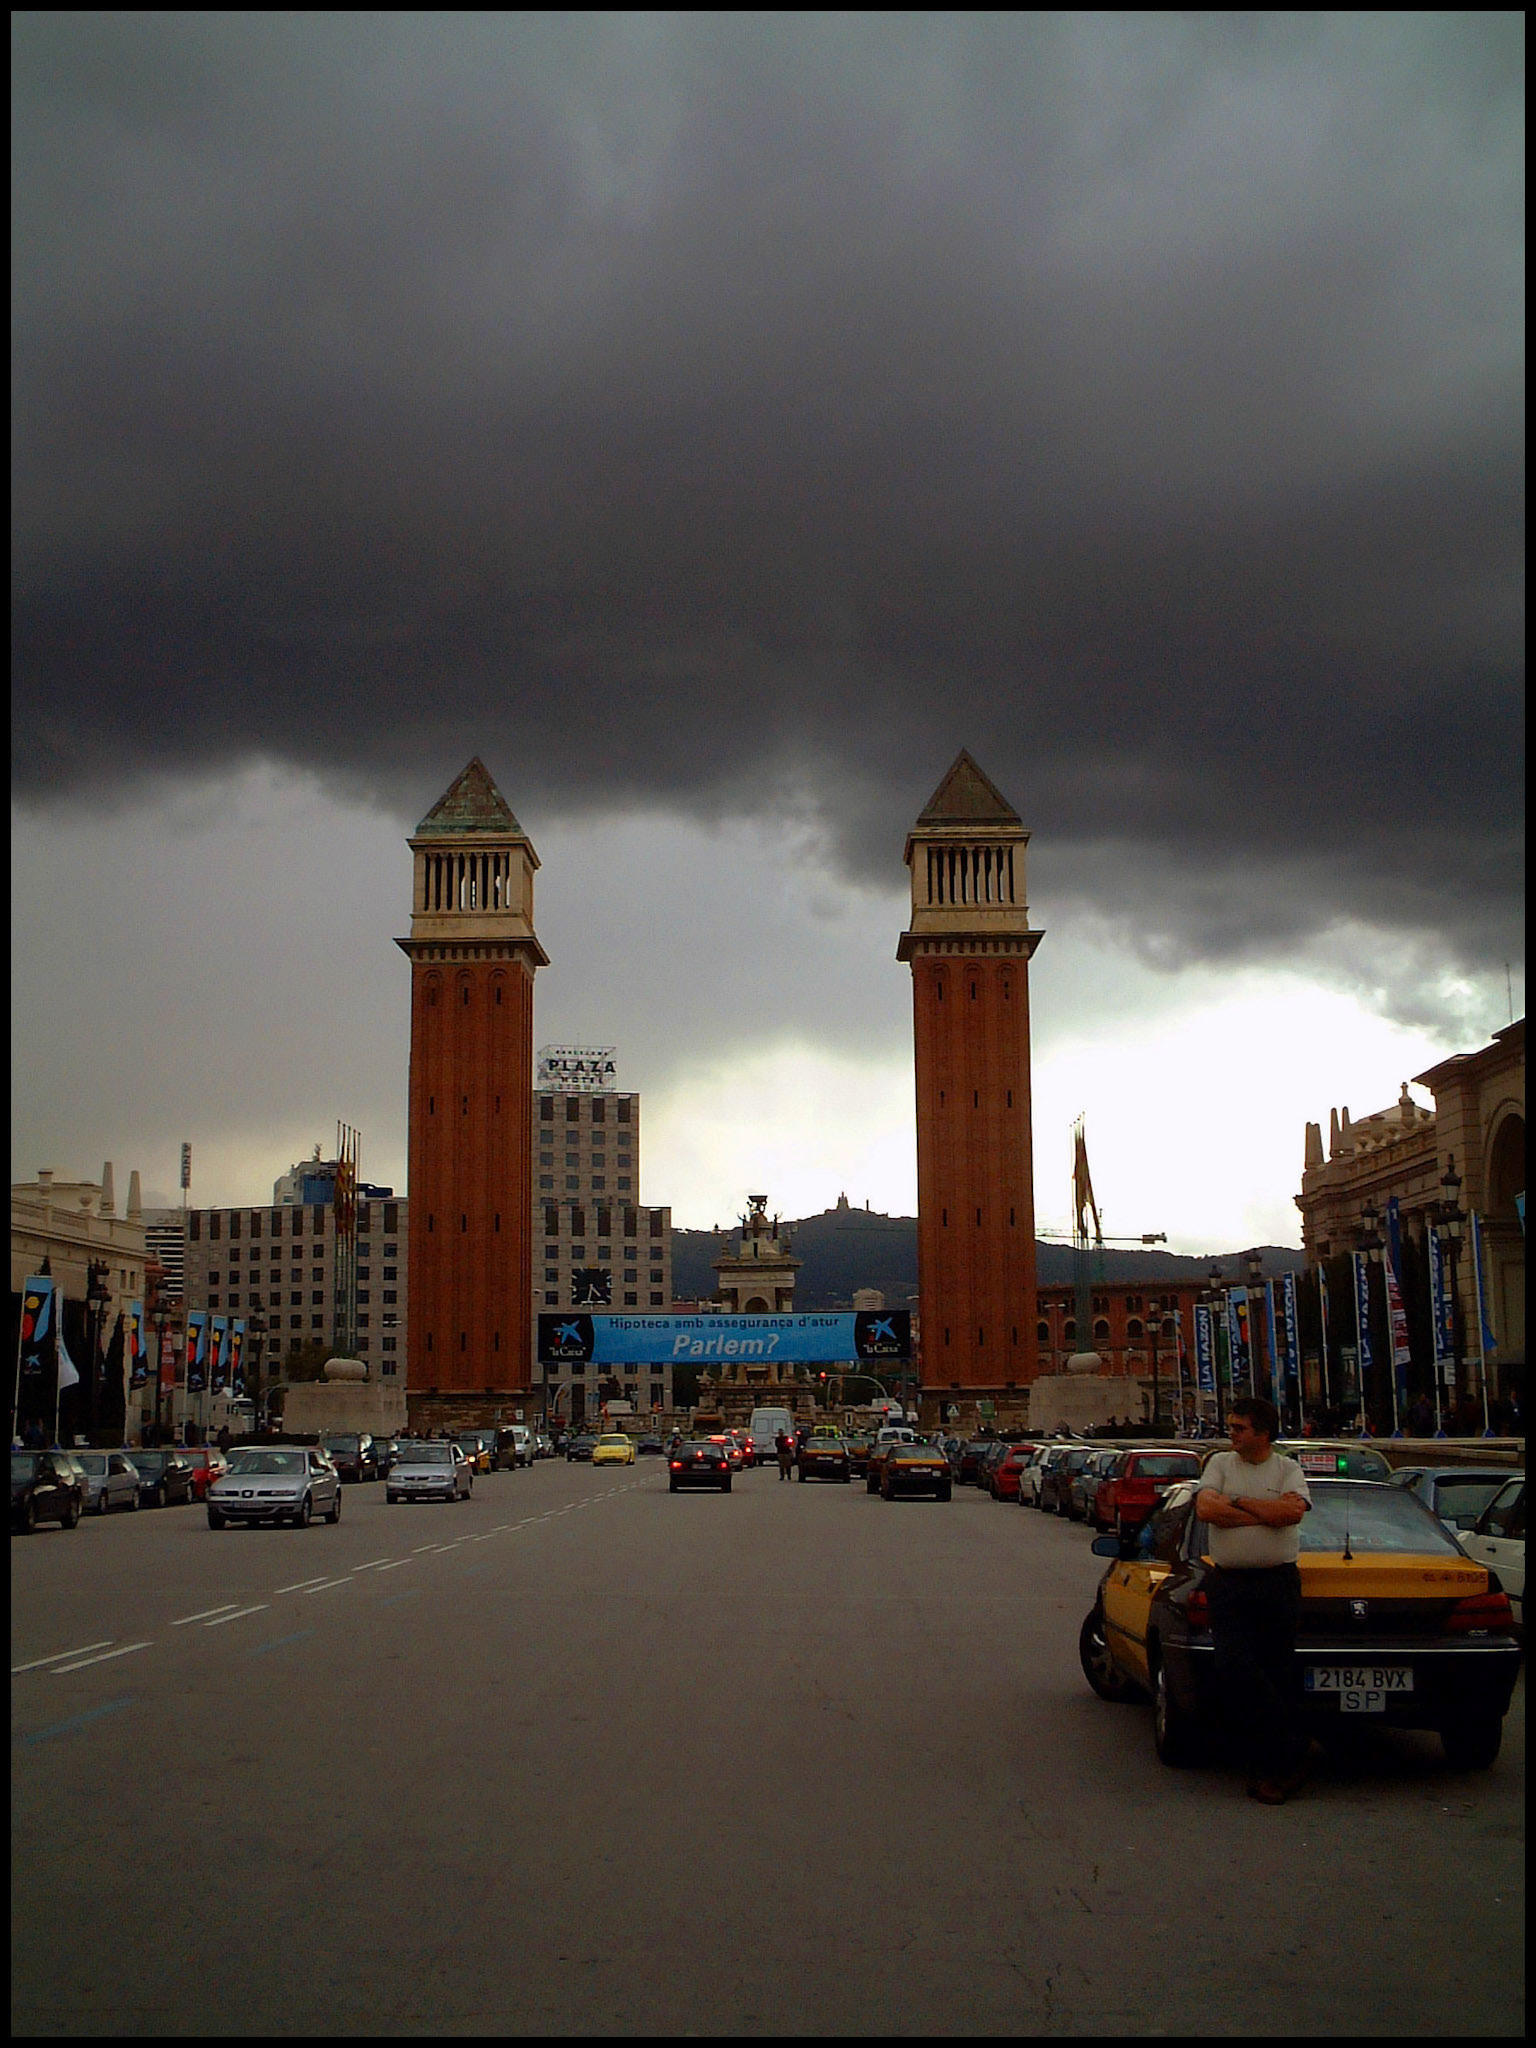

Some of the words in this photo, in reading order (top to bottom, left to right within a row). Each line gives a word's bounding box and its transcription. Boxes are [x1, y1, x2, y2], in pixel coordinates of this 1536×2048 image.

[548, 1059, 616, 1073] PLAZA
[609, 1317, 670, 1330] Hipoteca
[674, 1317, 704, 1329] amb
[708, 1317, 793, 1331] assegurança
[798, 1316, 839, 1328] d'atur
[672, 1333, 780, 1357] Parlem?
[1201, 1364, 1212, 1383] LA
[1320, 1670, 1366, 1688] 2184
[1373, 1670, 1406, 1688] BVX
[1346, 1691, 1380, 1710] SP
